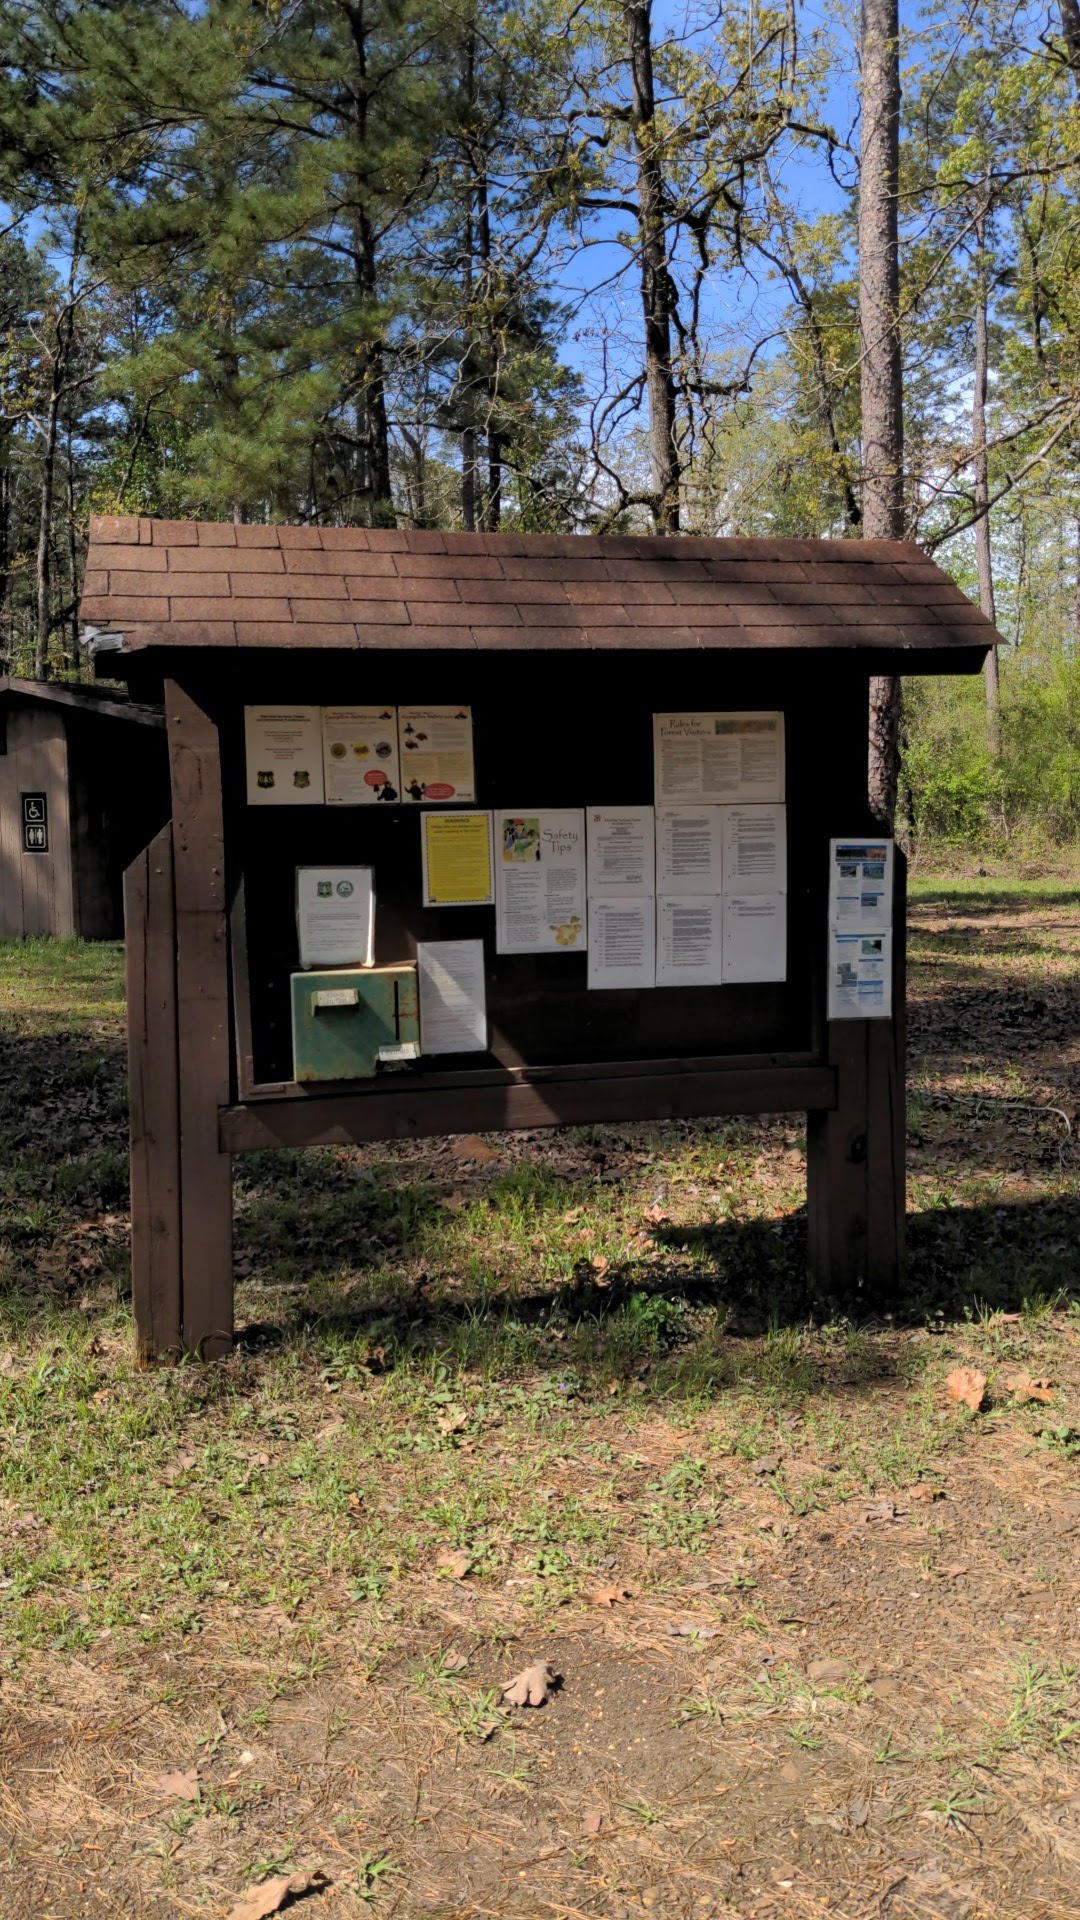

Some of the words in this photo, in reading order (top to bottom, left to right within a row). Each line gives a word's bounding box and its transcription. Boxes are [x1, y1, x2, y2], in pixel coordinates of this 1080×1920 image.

[669, 719, 690, 728] Rules
[690, 718, 702, 727] for
[660, 727, 682, 737] Forest
[682, 728, 711, 737] Visitors
[543, 828, 578, 843] Safety
[550, 841, 572, 856] Tips
